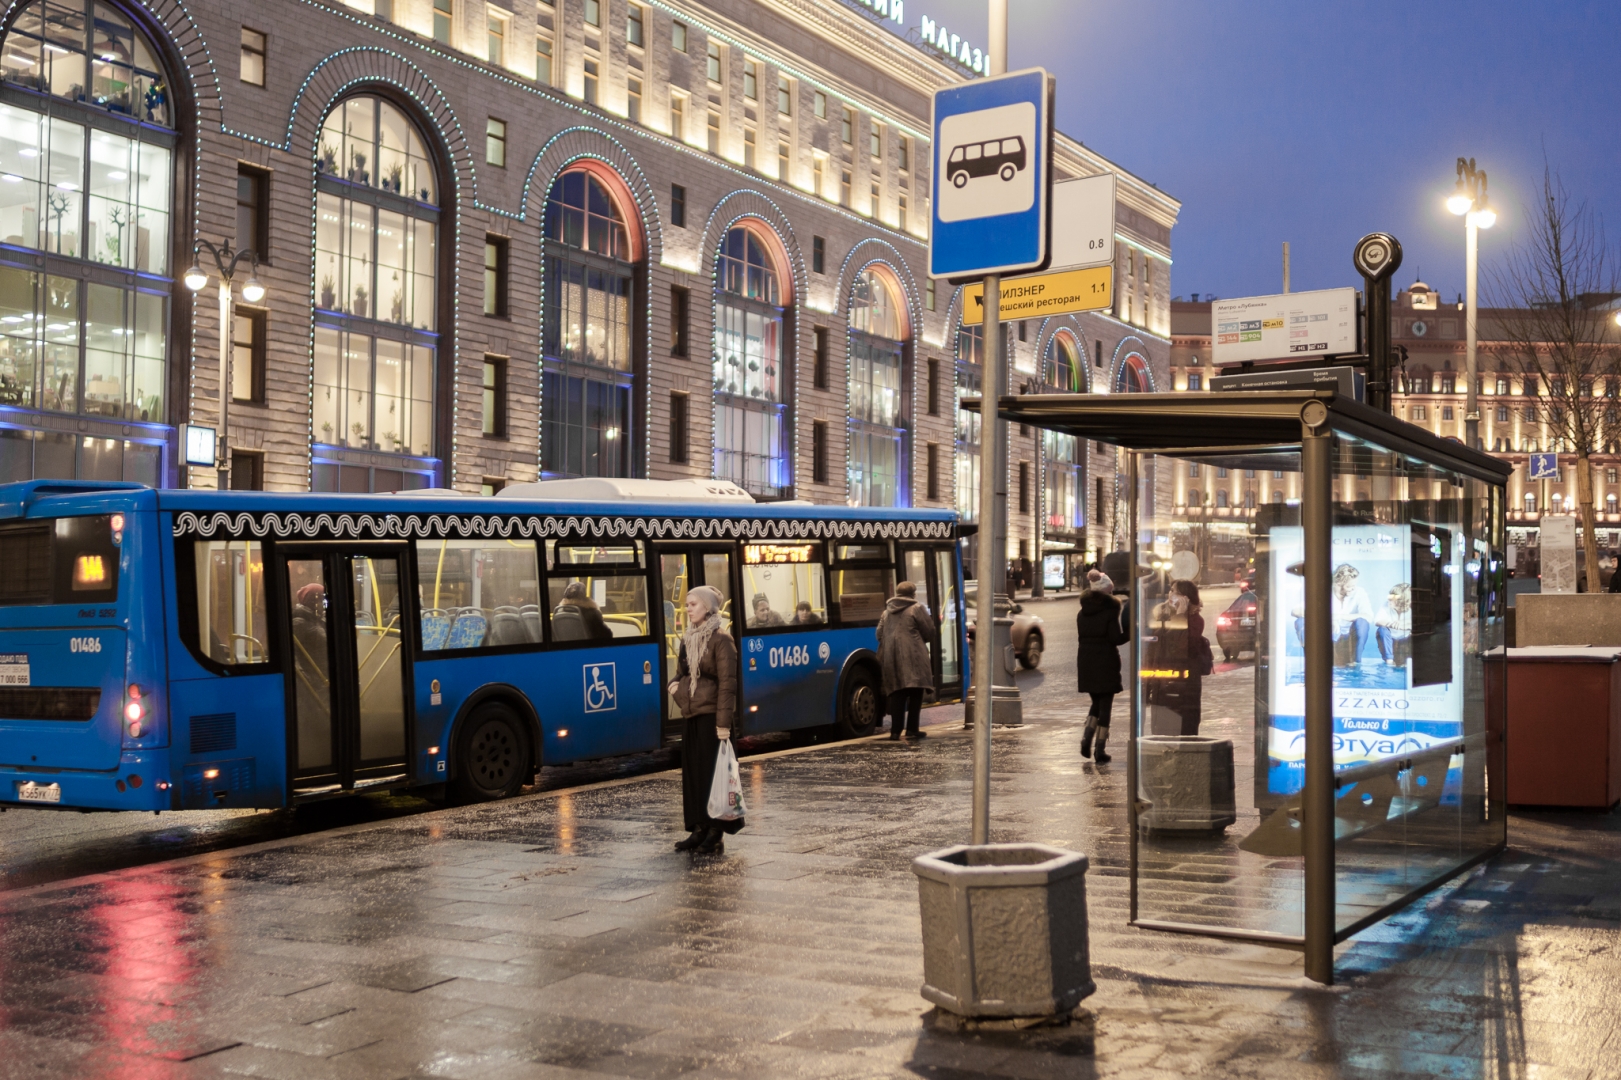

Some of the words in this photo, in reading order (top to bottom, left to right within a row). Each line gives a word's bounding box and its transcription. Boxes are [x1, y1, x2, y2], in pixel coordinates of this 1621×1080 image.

[1088, 239, 1104, 250] 0.8
[1091, 282, 1106, 294] 1.1
[1000, 299, 1034, 312] ешский
[1036, 295, 1081, 309] ресторан
[70, 637, 102, 653] 01486
[769, 645, 810, 668] 01486
[1338, 697, 1410, 710] ZZARO
[1342, 718, 1380, 730] Только
[1381, 719, 1389, 730] в
